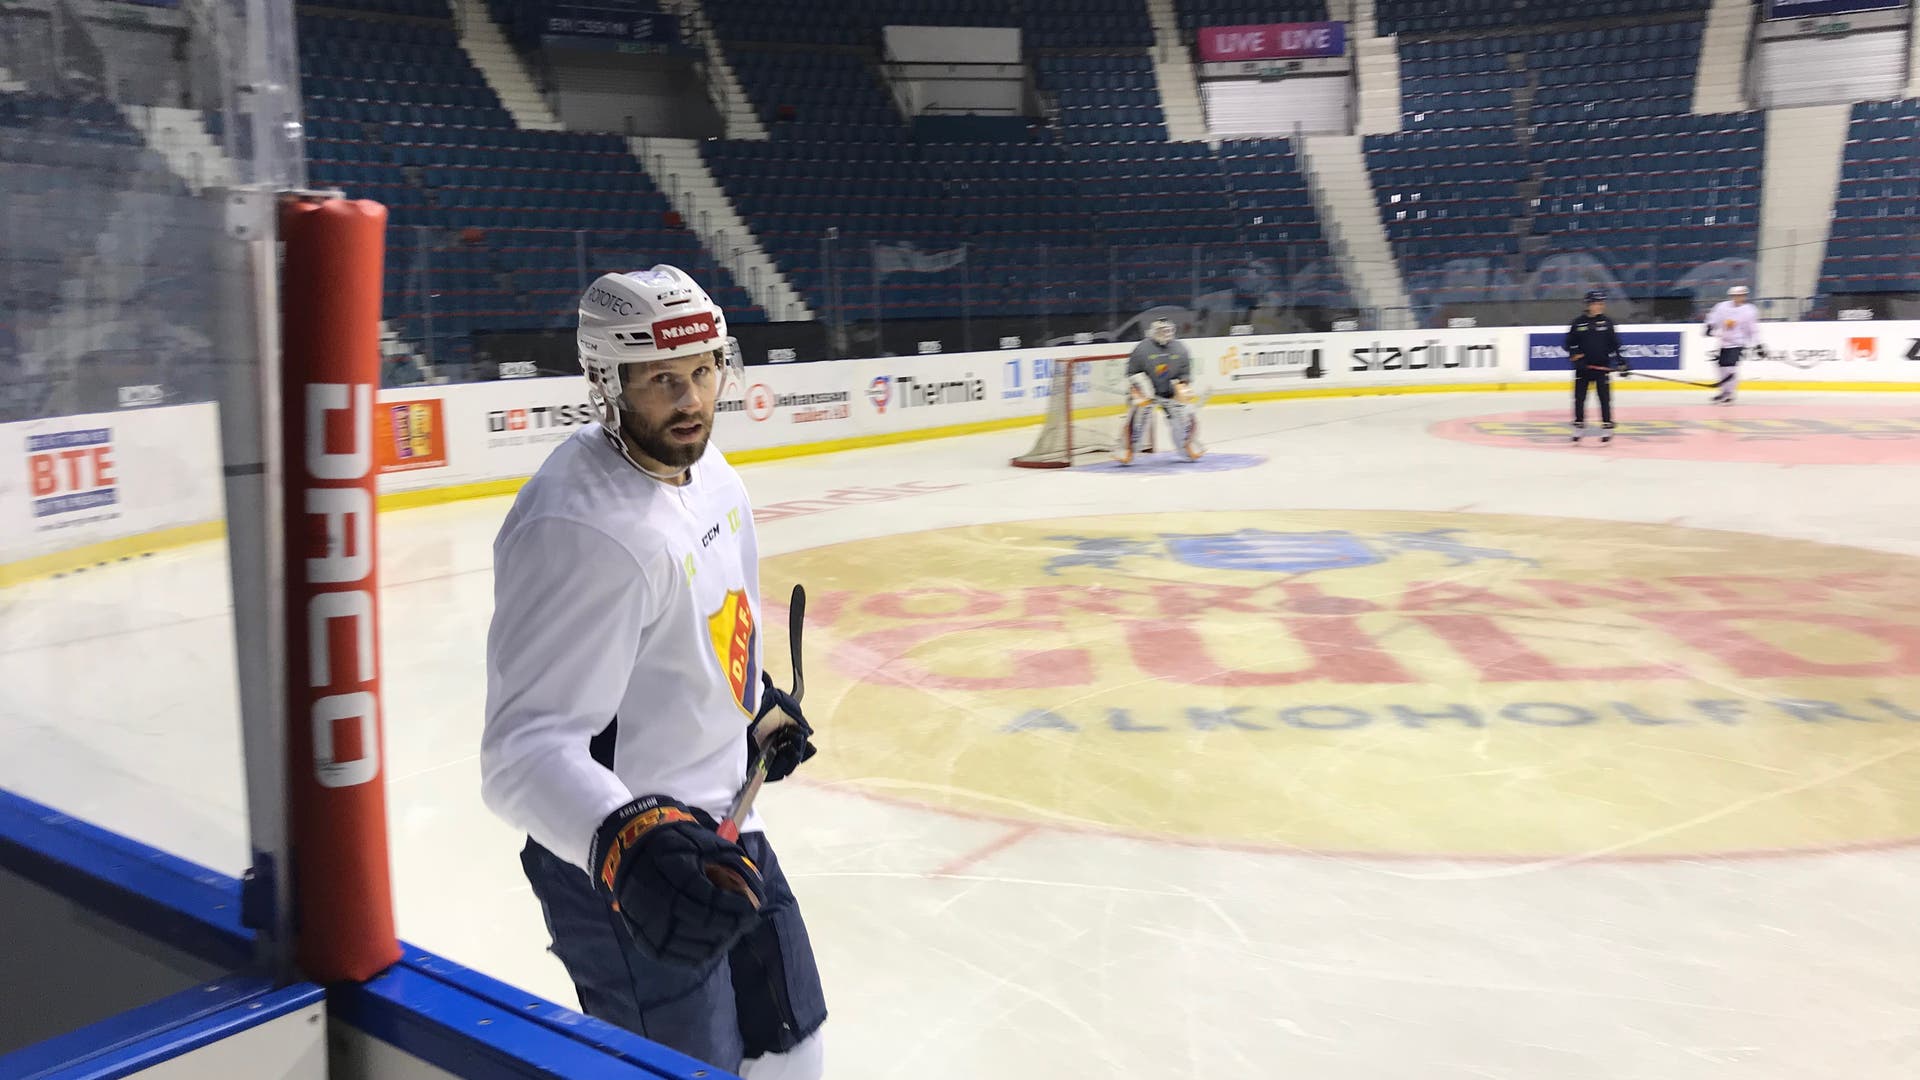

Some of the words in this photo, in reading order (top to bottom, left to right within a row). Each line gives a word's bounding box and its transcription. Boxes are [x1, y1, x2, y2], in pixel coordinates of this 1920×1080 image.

[1215, 31, 1266, 54] LIVE
[1279, 28, 1331, 50] LIVE
[661, 321, 710, 340] Miele
[1351, 340, 1498, 372] stadium
[897, 374, 987, 409] Thermia
[27, 445, 119, 497] BTE
[702, 523, 720, 548] CCM
[304, 383, 379, 788] DACO
[827, 609, 1920, 691] GULD
